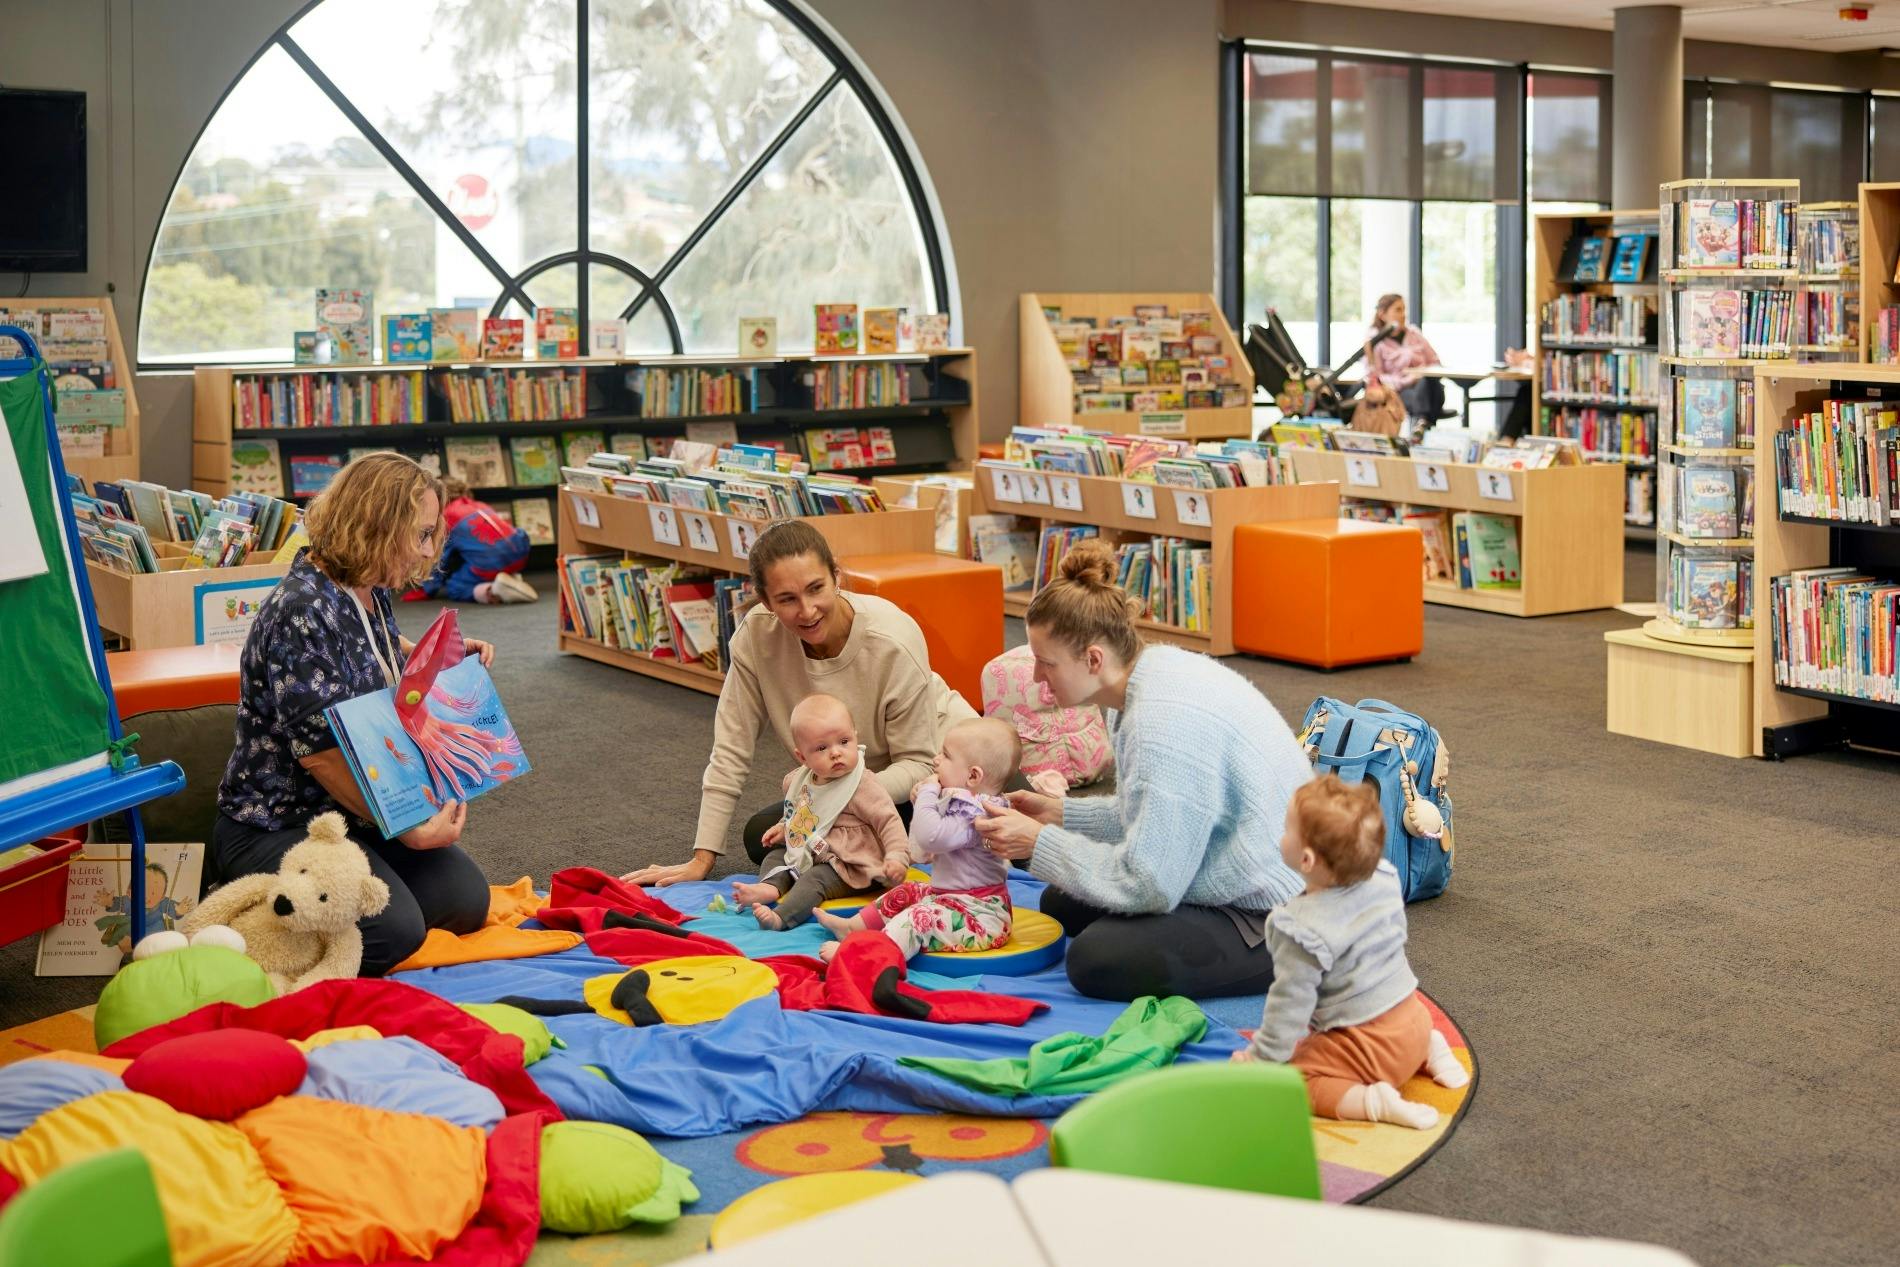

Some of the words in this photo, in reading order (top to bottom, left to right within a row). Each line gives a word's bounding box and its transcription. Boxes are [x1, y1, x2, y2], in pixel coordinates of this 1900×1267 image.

[79, 866, 104, 875] Little
[69, 877, 104, 886] NGERS
[70, 892, 86, 900] and
[73, 906, 98, 916] Little
